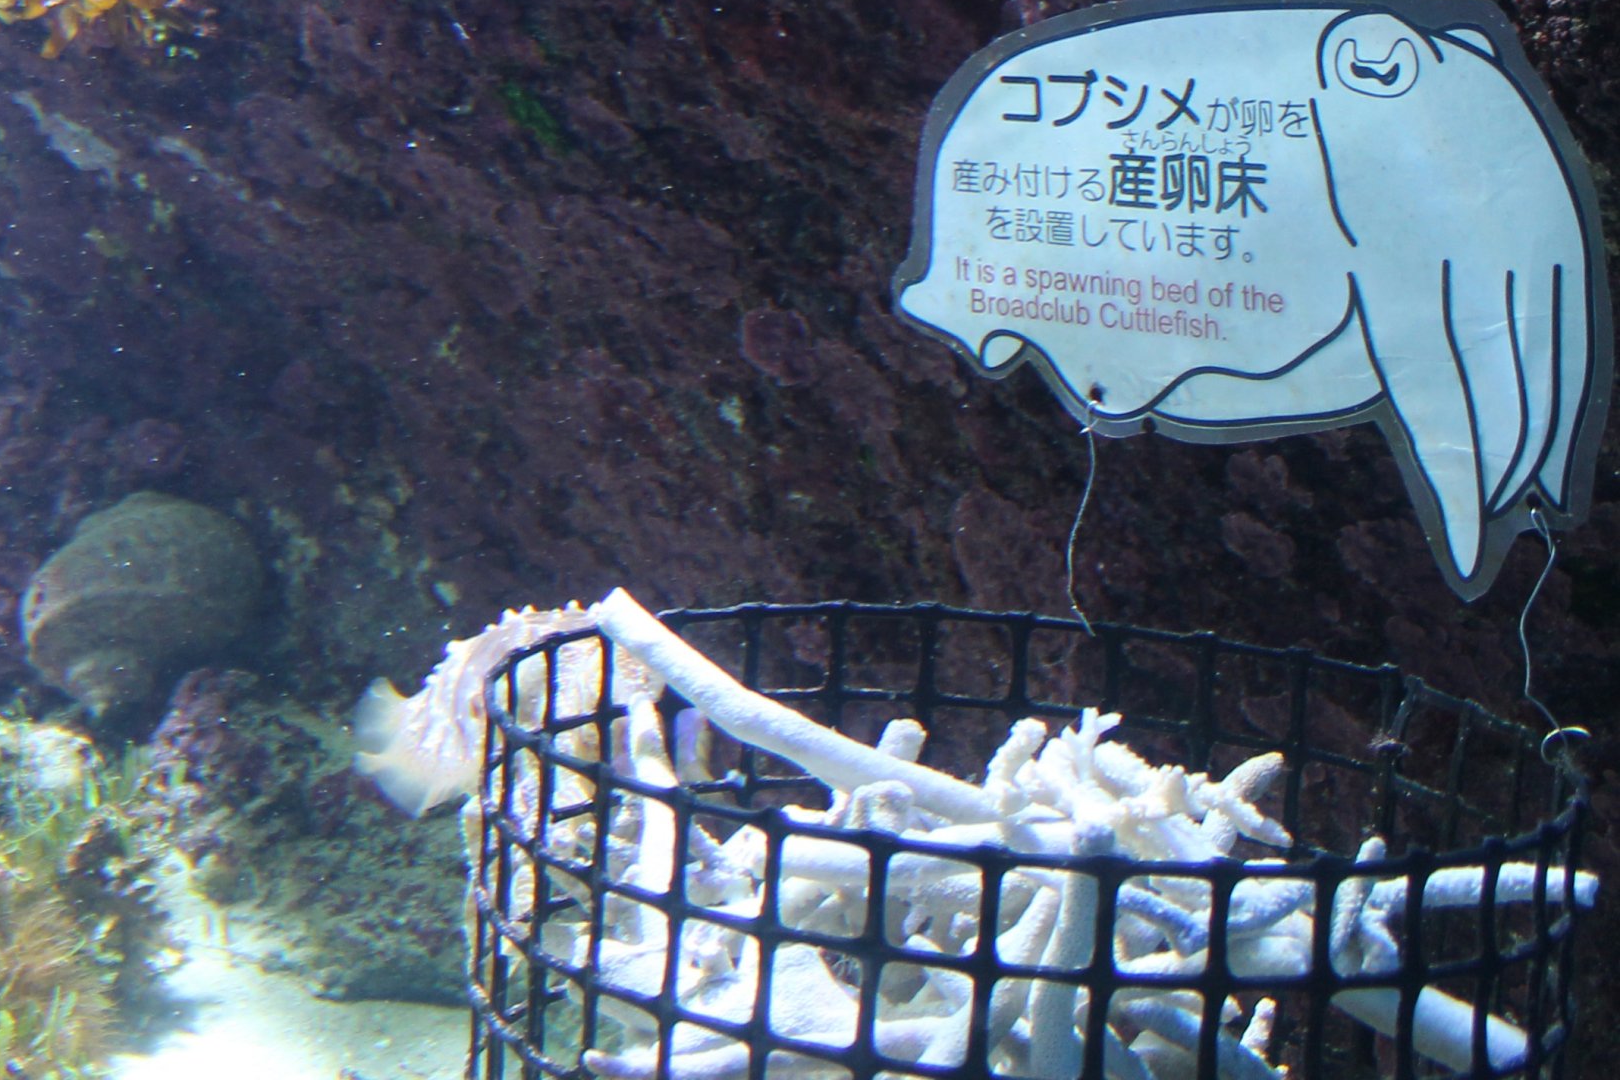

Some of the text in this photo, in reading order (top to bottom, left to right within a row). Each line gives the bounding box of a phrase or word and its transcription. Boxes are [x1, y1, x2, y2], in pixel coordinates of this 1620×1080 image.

[1000, 69, 1309, 138] コブシメが卵を
[1120, 130, 1253, 156] さんらんしょう
[952, 146, 1268, 218] 産み付ける産卵床
[985, 206, 1254, 264] を設置しています。
[956, 256, 1285, 314] It is a spawning bed of the
[970, 288, 1228, 341] Broadclub Cuttlefish.
